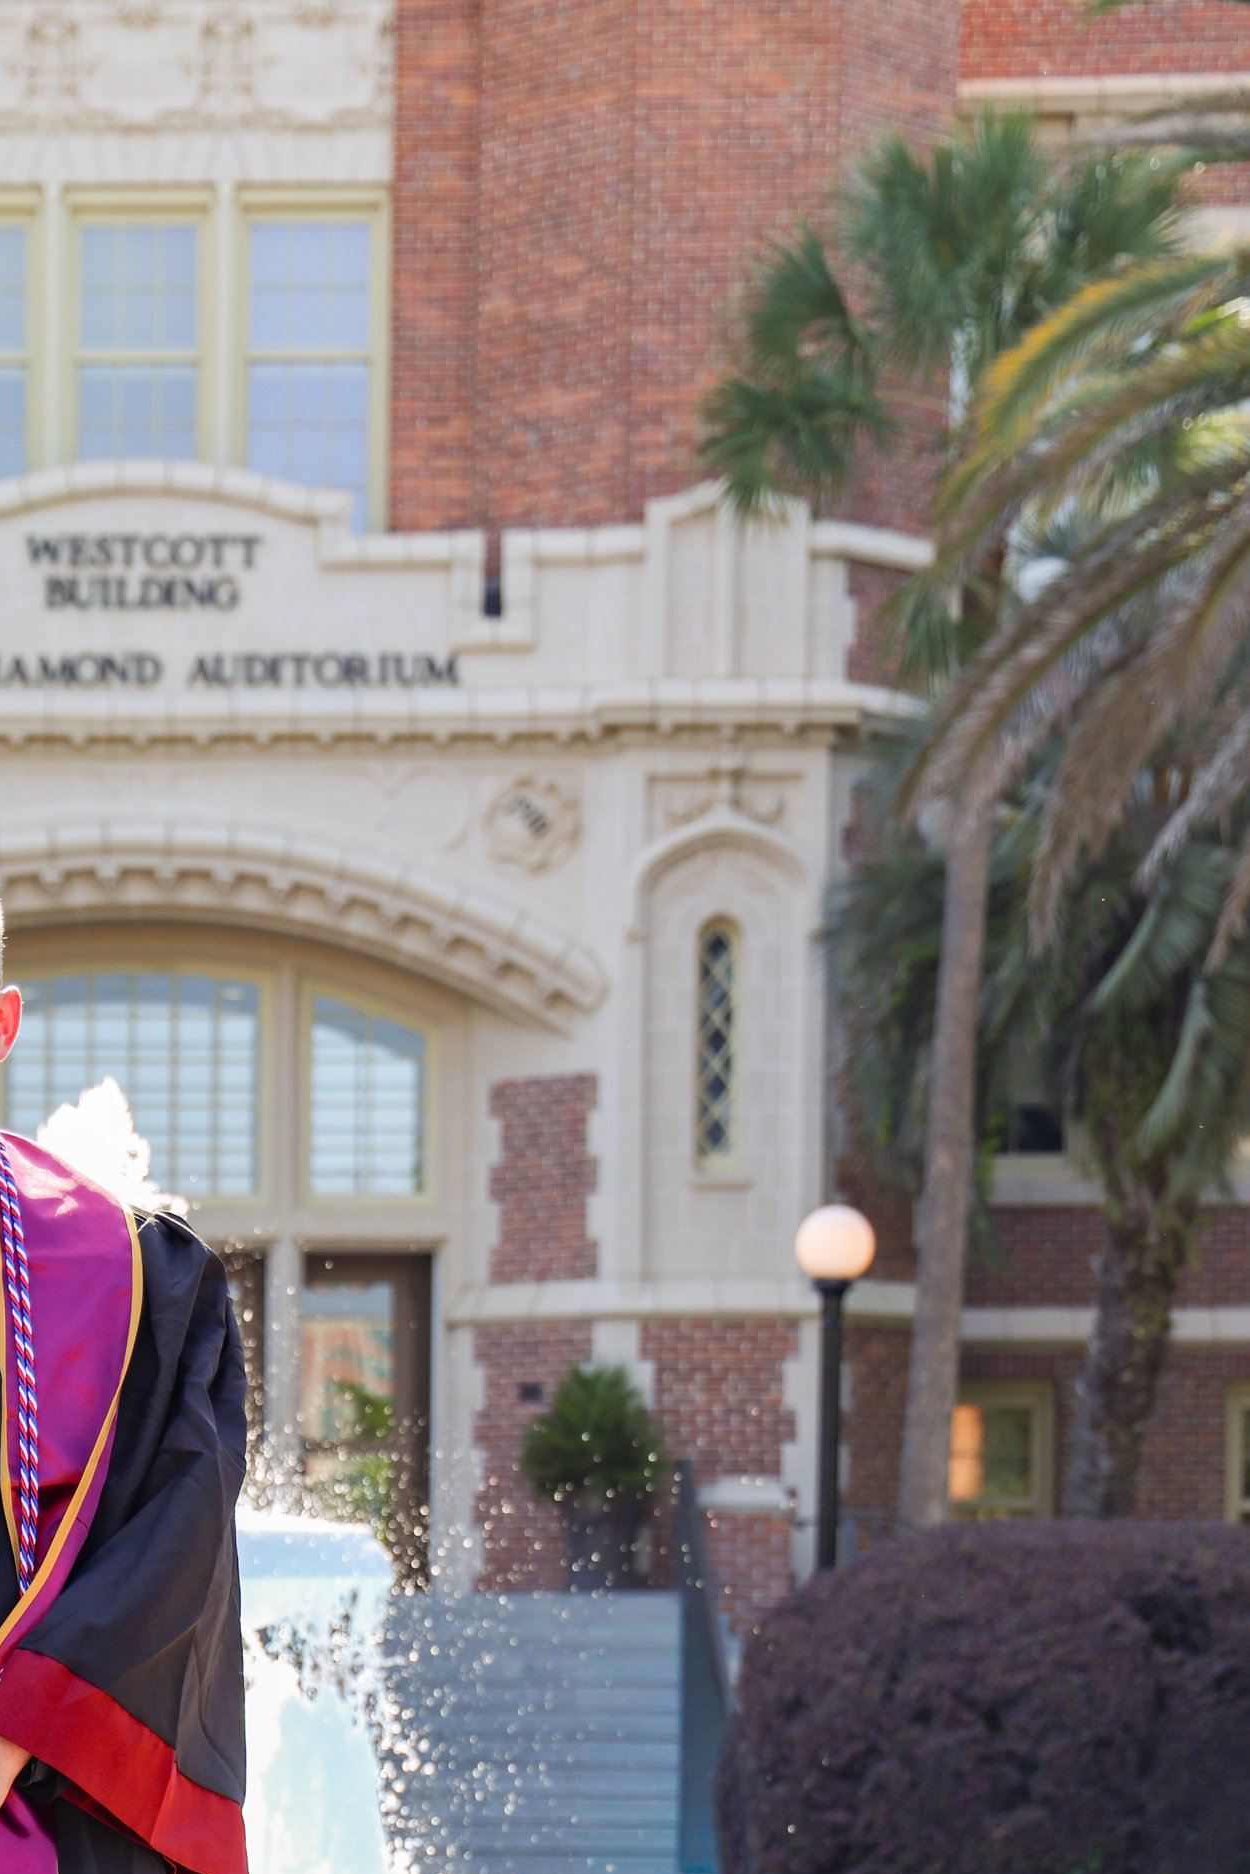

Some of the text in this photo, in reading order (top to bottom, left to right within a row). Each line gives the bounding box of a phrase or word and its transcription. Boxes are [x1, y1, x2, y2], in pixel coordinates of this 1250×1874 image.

[26, 534, 262, 569] WESTCOTT
[46, 576, 239, 611] BUILDING
[186, 653, 460, 688] AUDITORIUM
